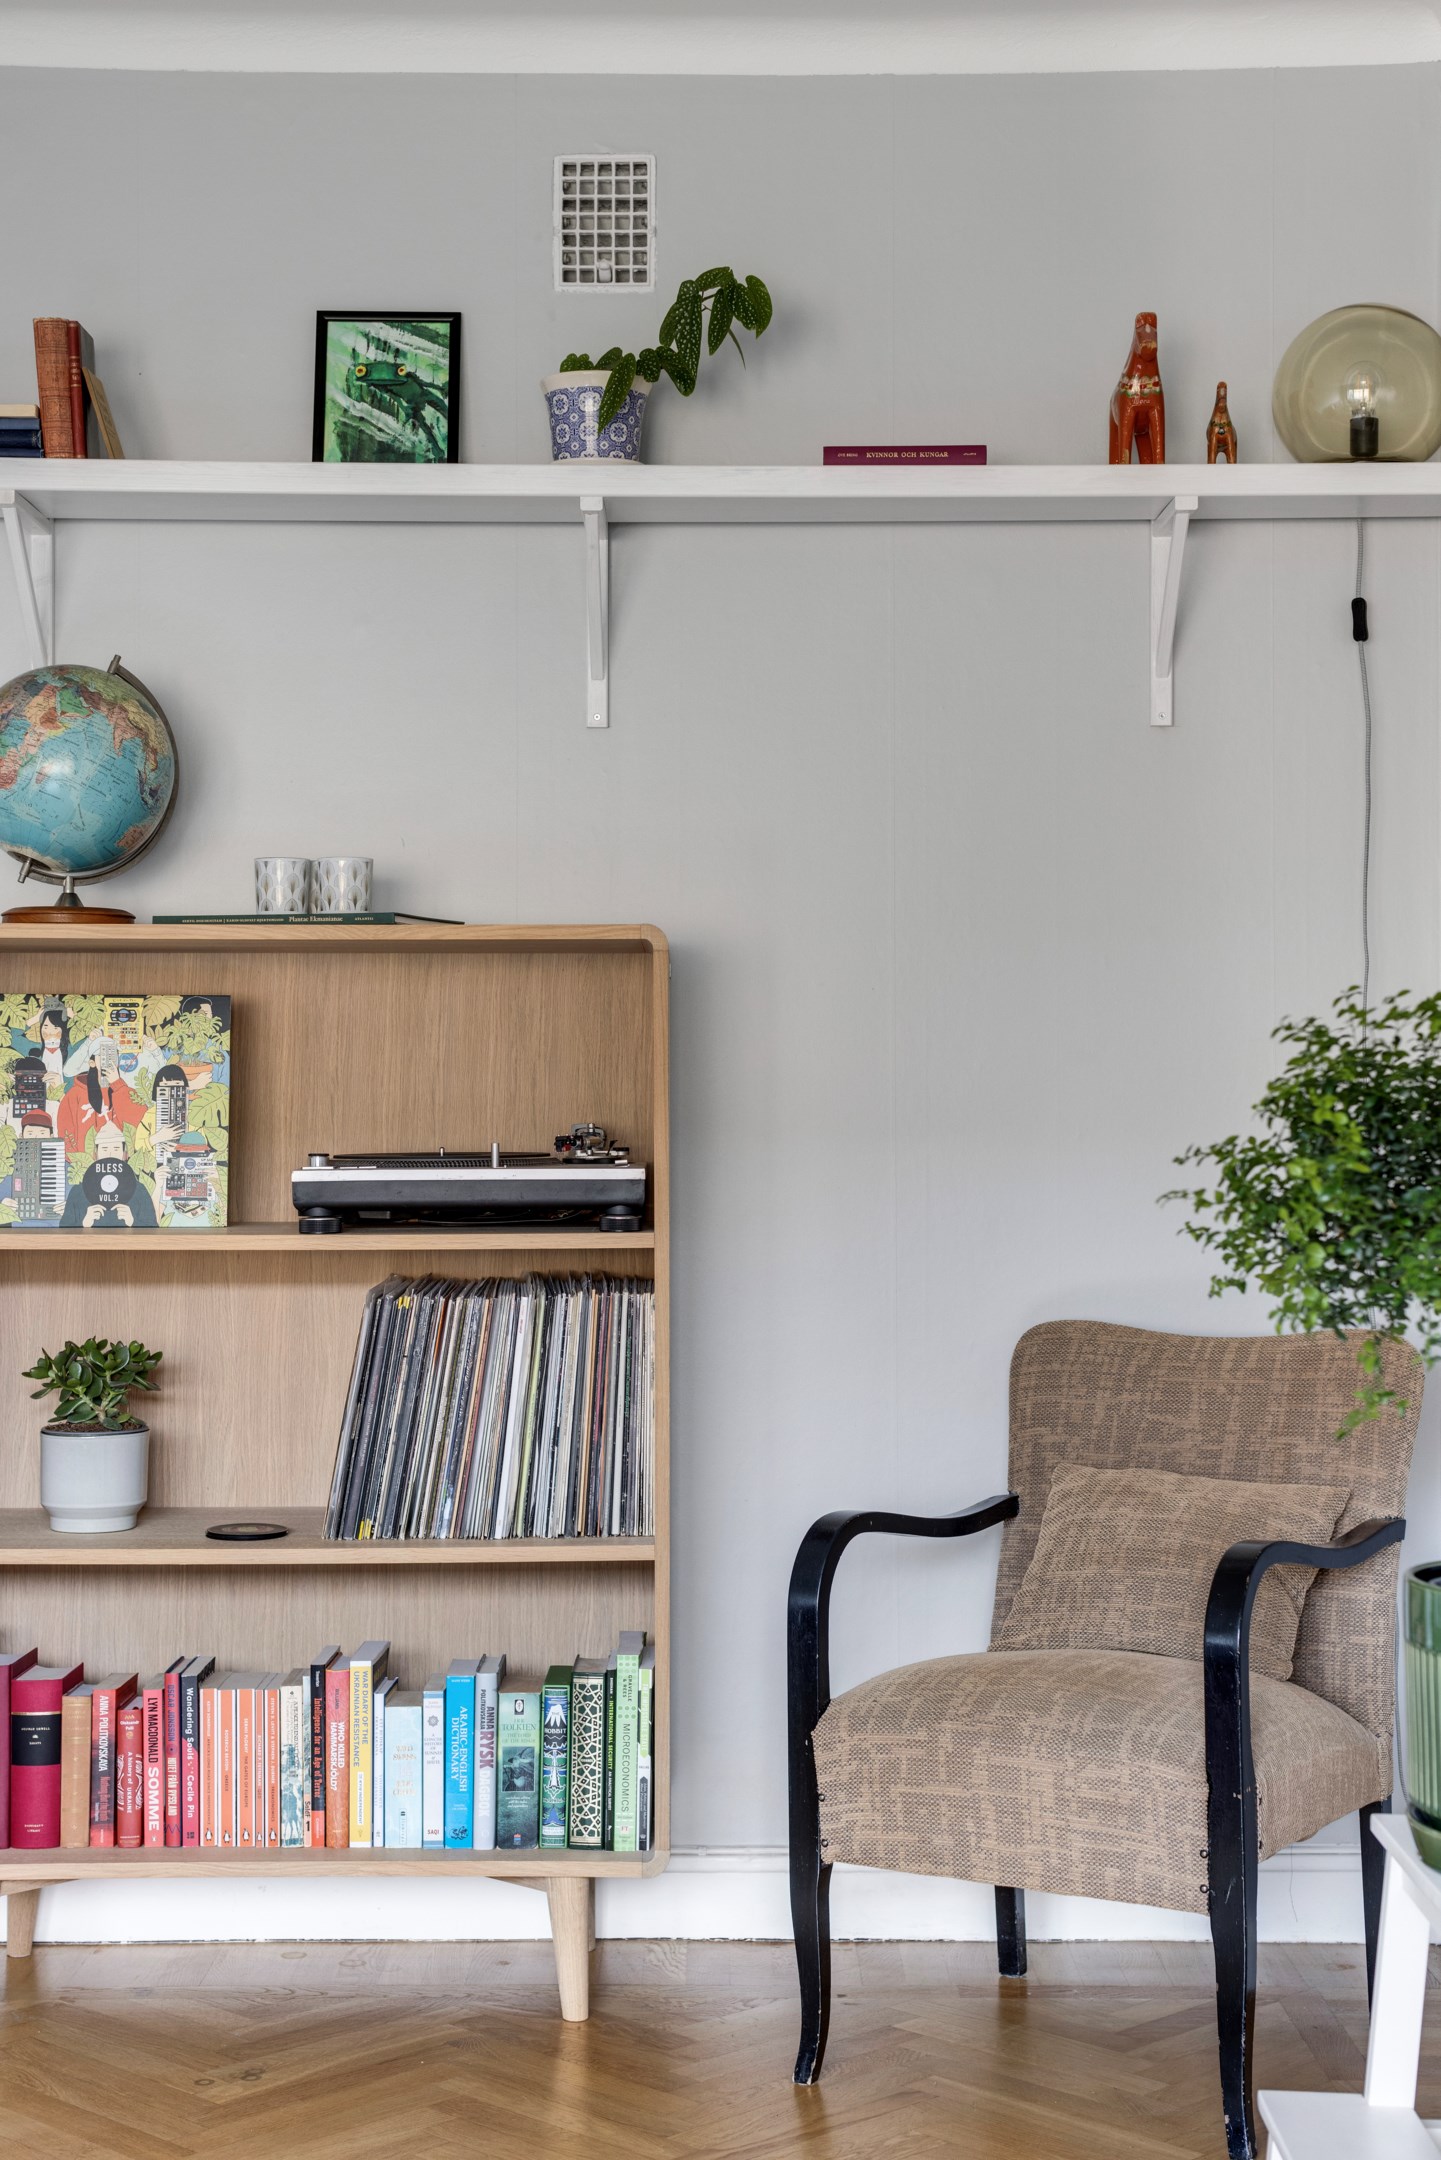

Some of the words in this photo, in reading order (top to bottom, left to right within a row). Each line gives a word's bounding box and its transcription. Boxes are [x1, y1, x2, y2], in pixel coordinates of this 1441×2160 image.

[95, 1163, 123, 1173] BLESS
[99, 1194, 119, 1202] VOL.2
[99, 1695, 109, 1715] ANNA
[148, 1698, 158, 1712] LYN
[185, 1688, 193, 1734] Wandering
[313, 1698, 322, 1733] Intelligence
[362, 1716, 368, 1727] OF
[99, 1717, 109, 1772] POLITKOVSKAYA
[148, 1714, 158, 1763] MACDONALD
[314, 1736, 322, 1744] for
[451, 1718, 459, 1780] DICTIONARY
[460, 1706, 468, 1792] ARABIC-ENGLISH
[480, 1731, 494, 1769] RYSK
[168, 1758, 176, 1772] HOTET
[313, 1757, 322, 1768] Age
[621, 1723, 630, 1812] MICROECONOMICS
[168, 1775, 178, 1788] FRÅN
[314, 1779, 322, 1797] Terror
[148, 1767, 159, 1830] SOMME
[168, 1790, 177, 1816] RYSSLAND
[479, 1770, 490, 1817] DAGBOK
[306, 1821, 310, 1831] 1
